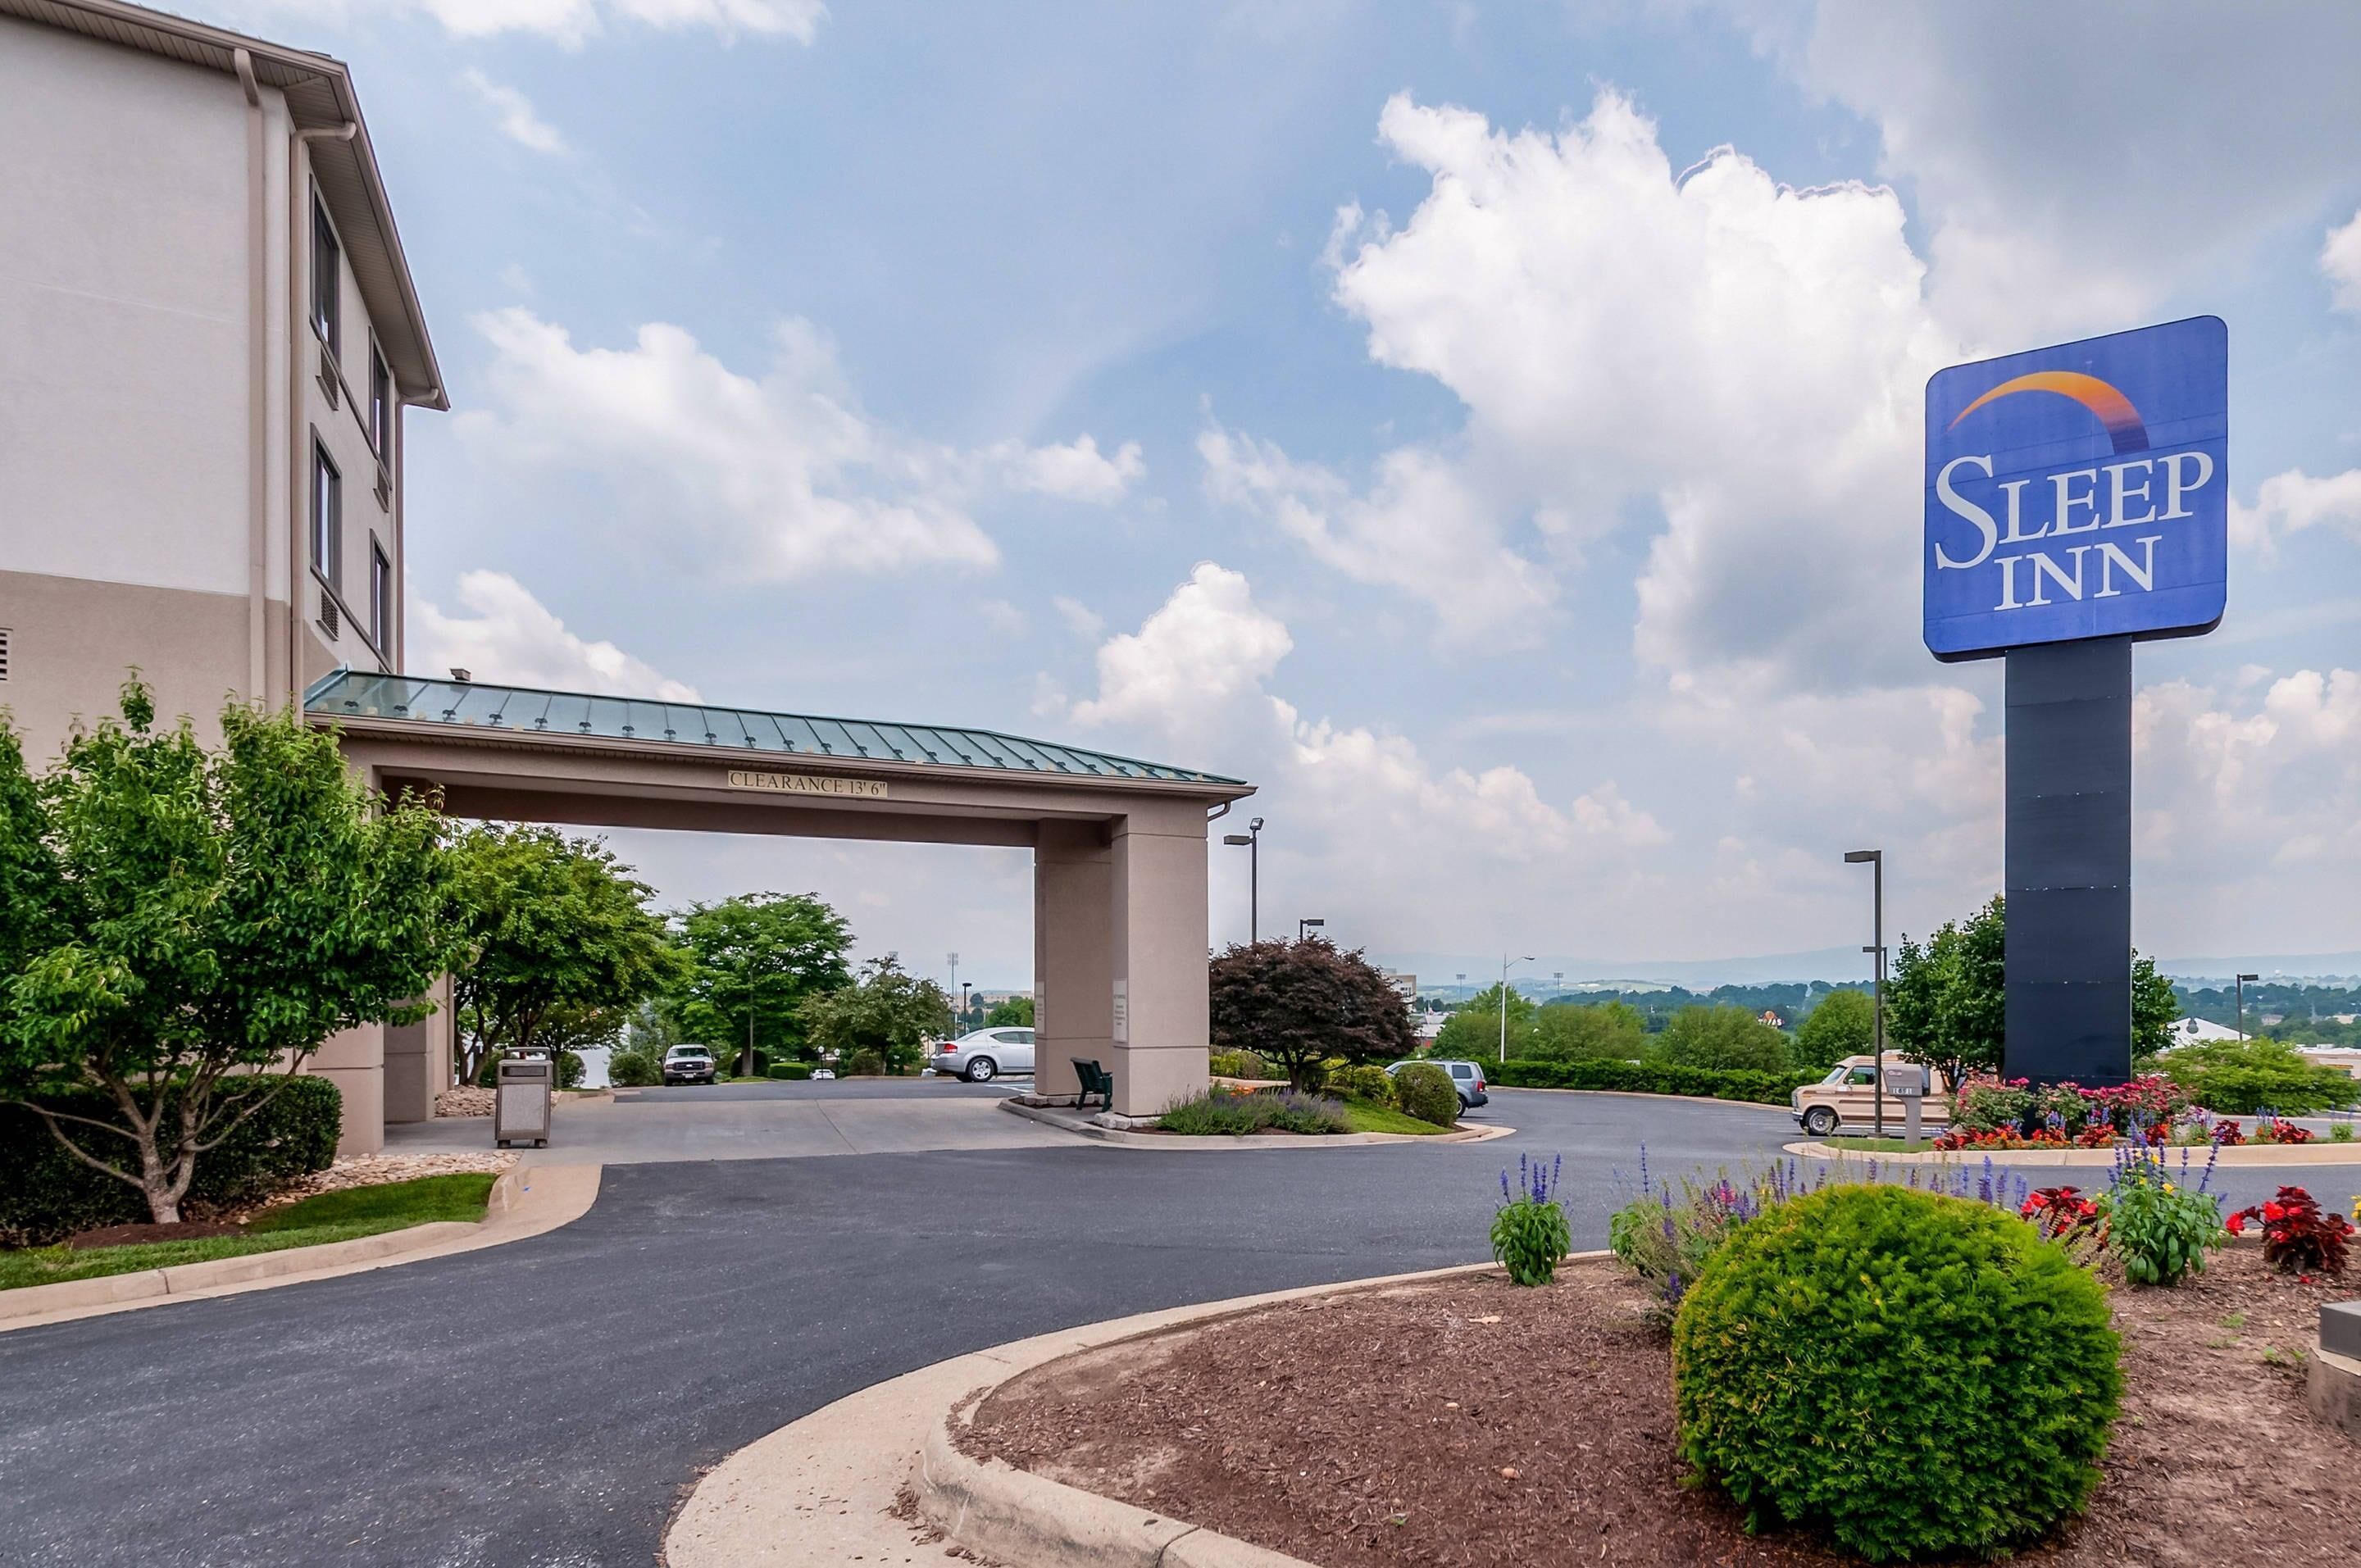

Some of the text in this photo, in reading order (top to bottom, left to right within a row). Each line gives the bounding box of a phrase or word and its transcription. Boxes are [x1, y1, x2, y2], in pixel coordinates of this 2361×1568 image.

[1934, 451, 2213, 570] SLEEP
[1994, 534, 2163, 611] INN
[730, 771, 885, 795] CLEARANCE 13' 6"
